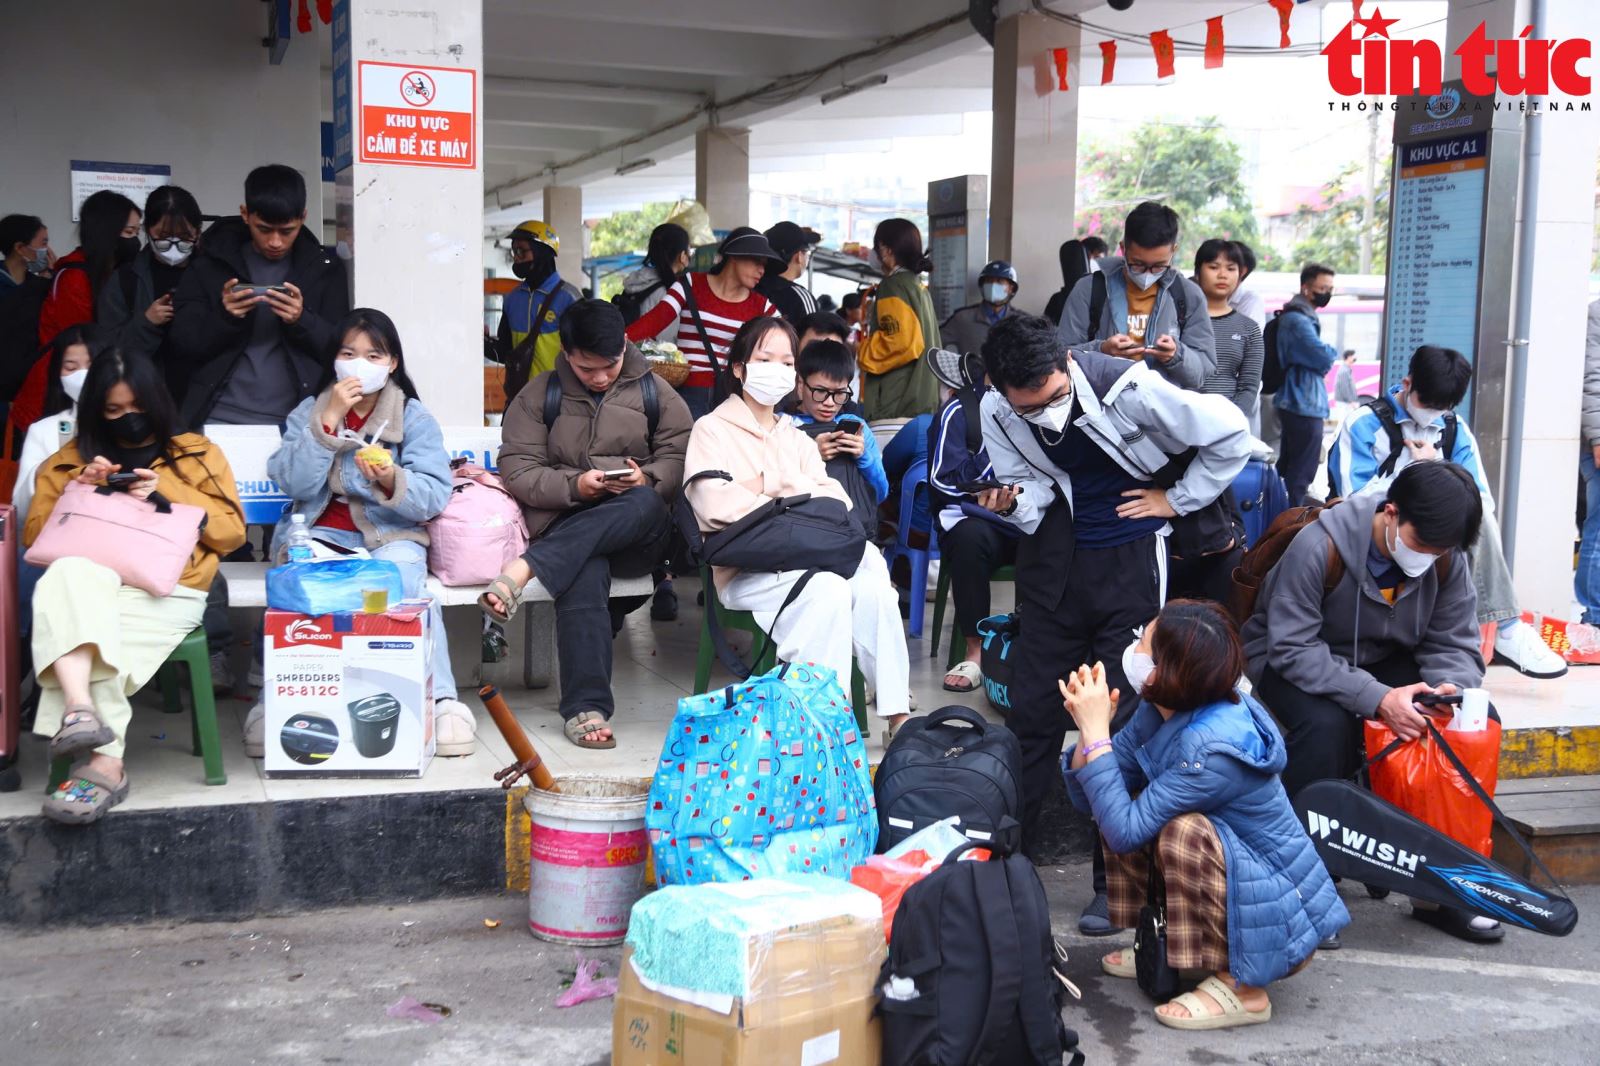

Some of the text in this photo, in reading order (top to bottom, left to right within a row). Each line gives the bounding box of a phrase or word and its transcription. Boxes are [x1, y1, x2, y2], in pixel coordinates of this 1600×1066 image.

[386, 113, 450, 133] KHU VỰC
[367, 130, 468, 158] CẤM ĐỂ XE MÁY
[1409, 140, 1477, 162] KHU VỰC A1
[276, 673, 341, 682] SHREDDERS
[277, 685, 339, 697] PS-812C
[1328, 841, 1415, 878] HIGH QUALITY BADMINTON RACKETS
[1341, 826, 1419, 872] WISH
[1450, 876, 1517, 904] FUSIONTEC
